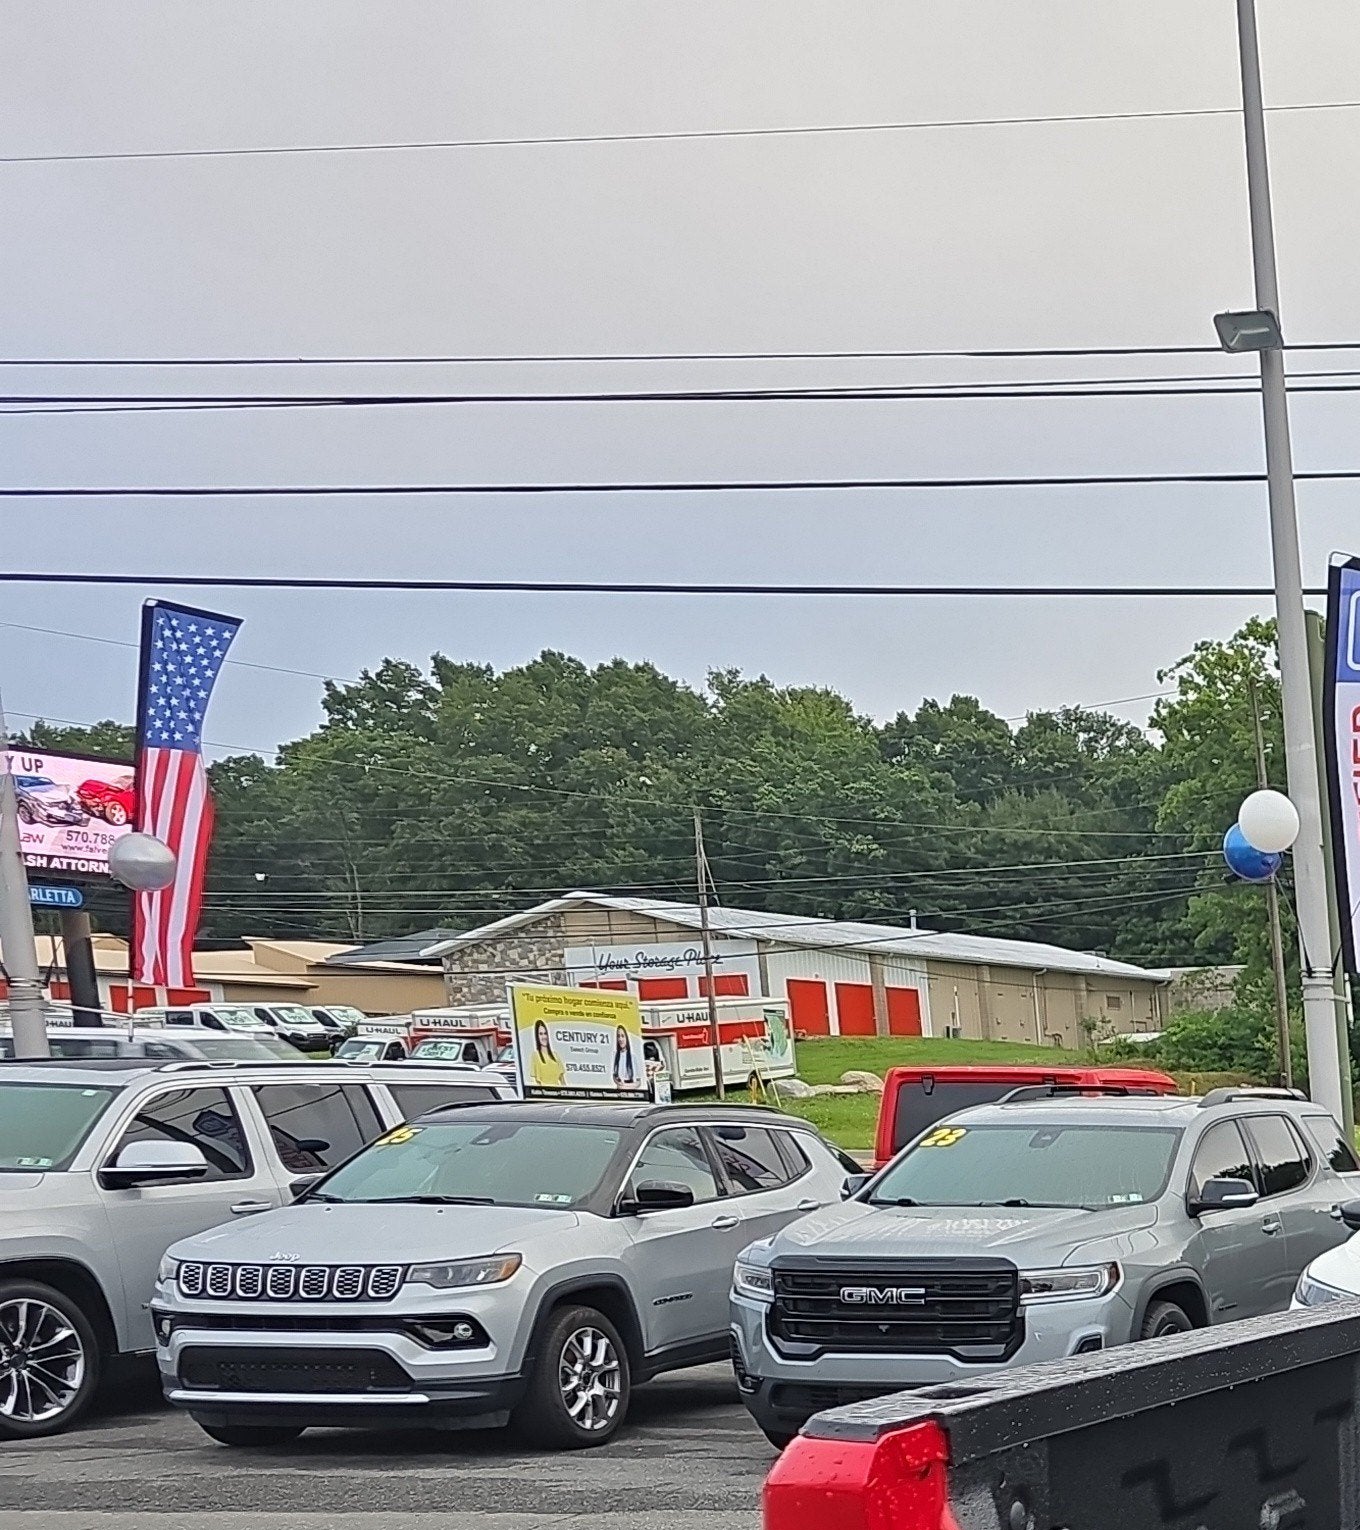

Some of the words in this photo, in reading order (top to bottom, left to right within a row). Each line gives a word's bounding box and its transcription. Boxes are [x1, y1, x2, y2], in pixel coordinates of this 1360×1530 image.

[20, 756, 44, 774] UP
[50, 858, 112, 874] ATTORN
[598, 952, 630, 971] Your
[633, 951, 683, 971] Storage
[420, 1018, 467, 1028] U-HAUL
[677, 1012, 709, 1023] U-HAU
[366, 1026, 402, 1035] U-HAUL
[556, 1030, 597, 1044] CENTURY
[599, 1033, 610, 1045] 21
[919, 1127, 967, 1147] 23
[270, 1251, 300, 1262] Jeep
[840, 1286, 925, 1305] GMC
